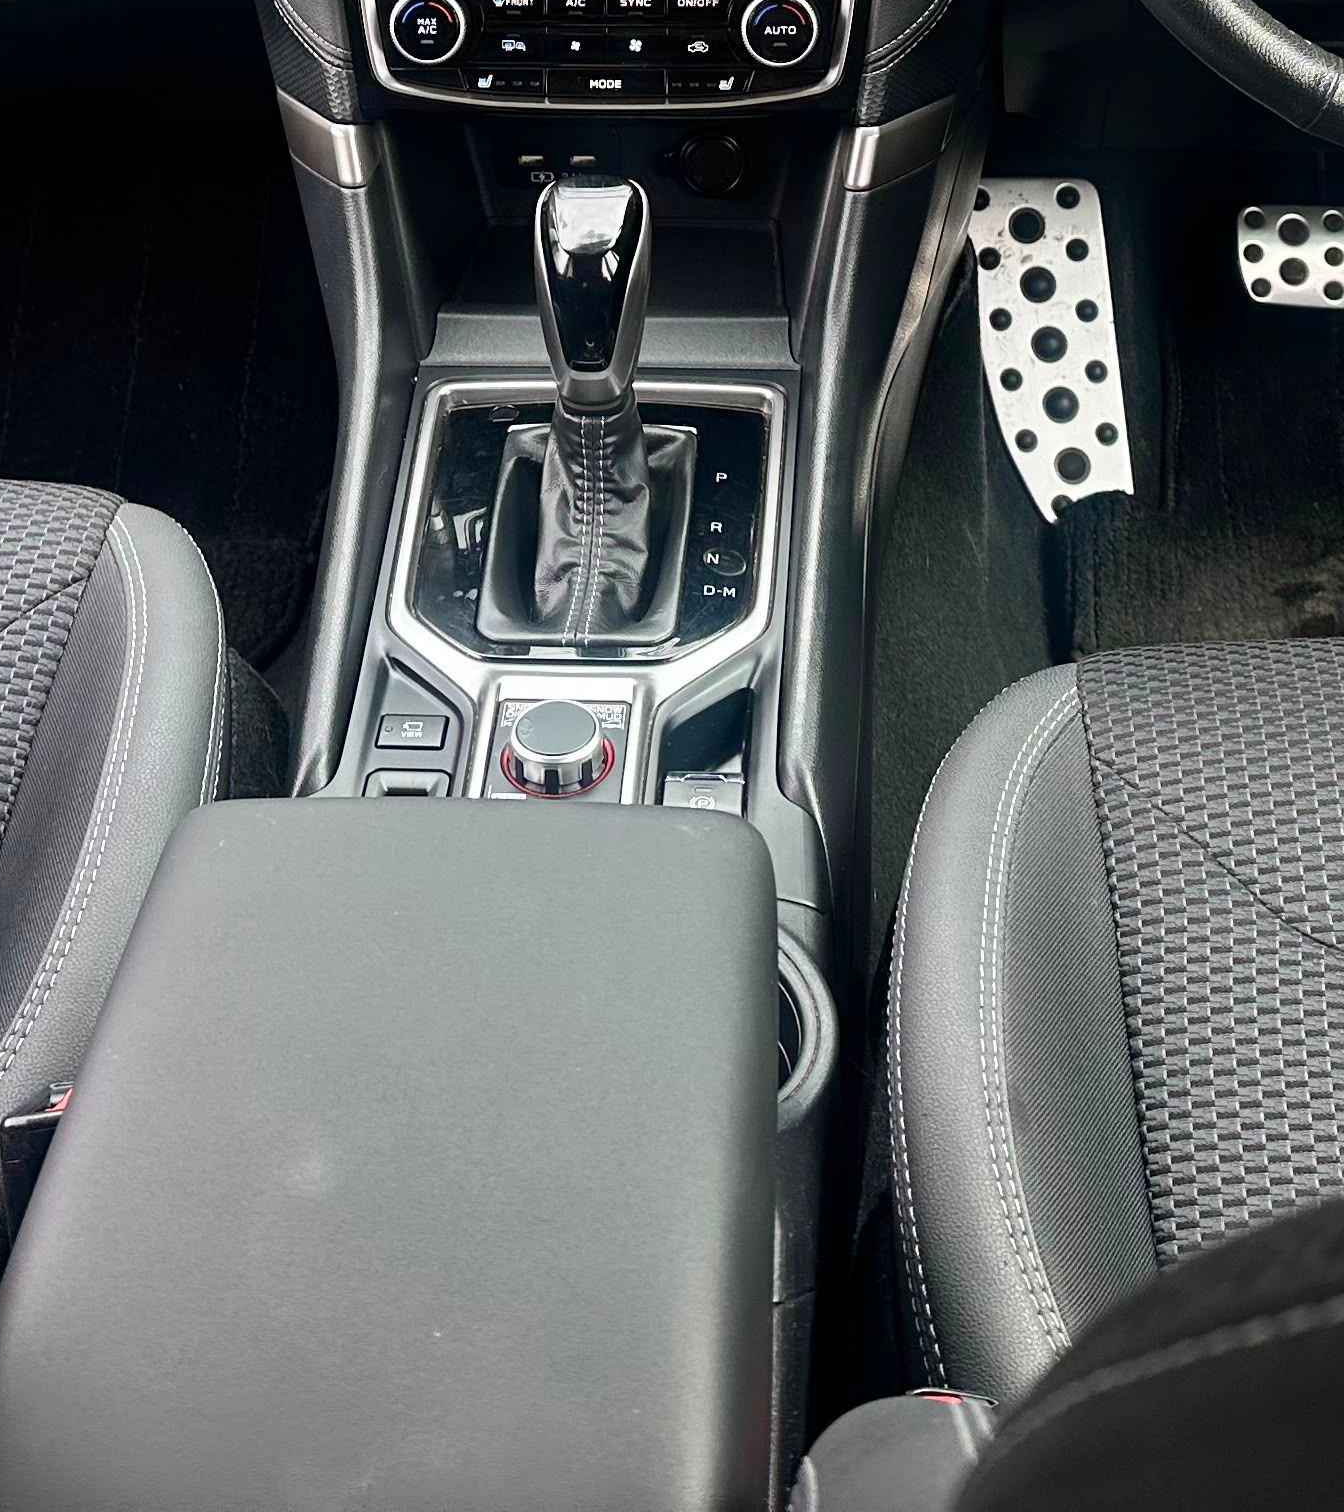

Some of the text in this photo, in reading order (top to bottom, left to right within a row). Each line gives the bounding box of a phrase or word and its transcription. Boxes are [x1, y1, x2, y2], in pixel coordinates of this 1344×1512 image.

[416, 17, 437, 26] MAX
[417, 25, 438, 35] A/C
[763, 25, 797, 35] AUTO
[589, 78, 622, 89] MODE
[715, 472, 728, 483] P
[710, 521, 723, 533] R
[706, 553, 720, 565] N
[703, 584, 736, 598] D-M
